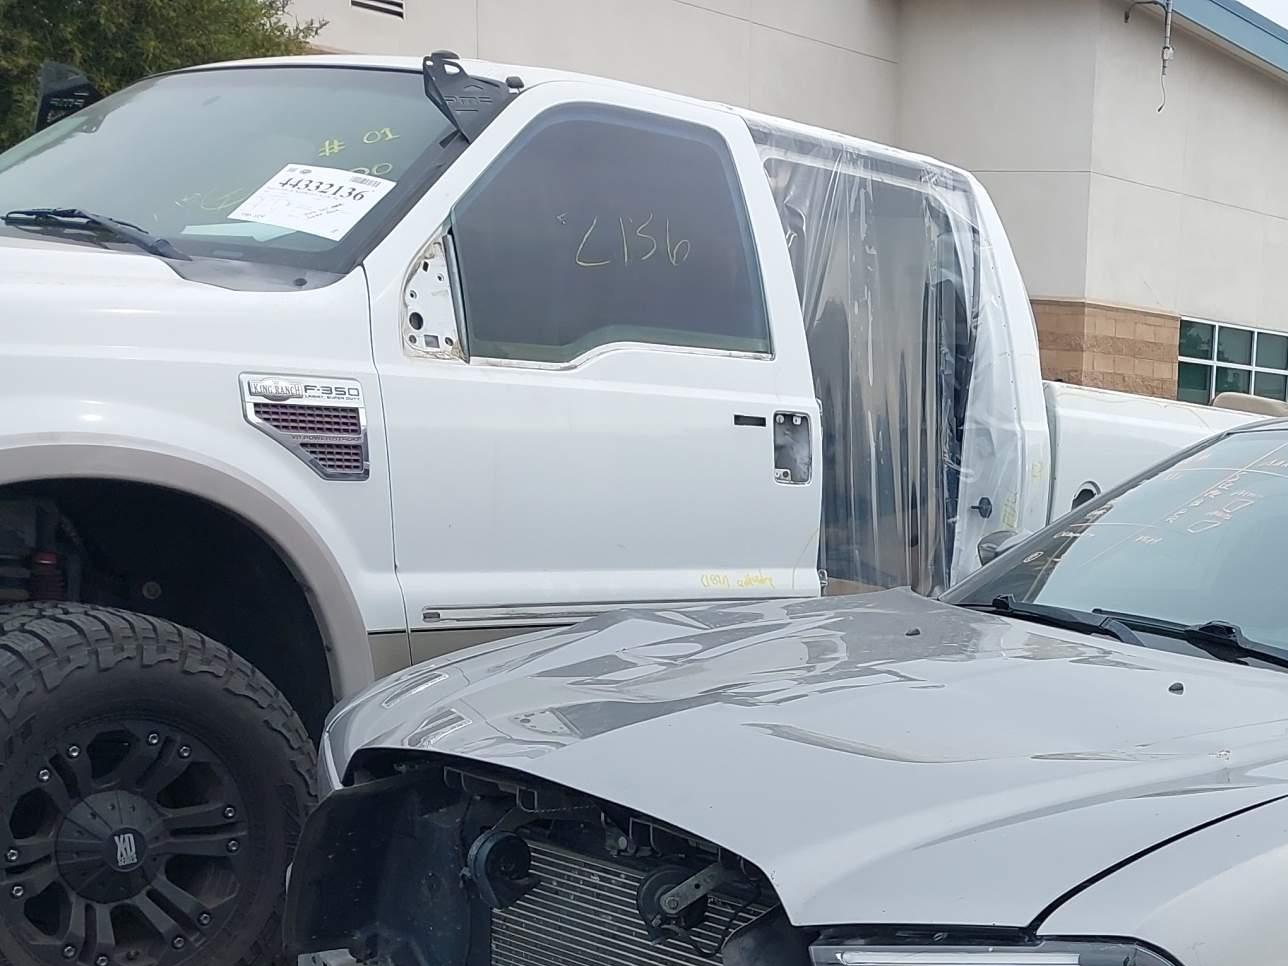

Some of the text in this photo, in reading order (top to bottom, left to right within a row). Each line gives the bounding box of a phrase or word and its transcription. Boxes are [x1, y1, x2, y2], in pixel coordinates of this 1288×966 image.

[278, 177, 370, 202] 44332136
[253, 383, 301, 396] KING RANCH
[303, 384, 360, 397] F-350
